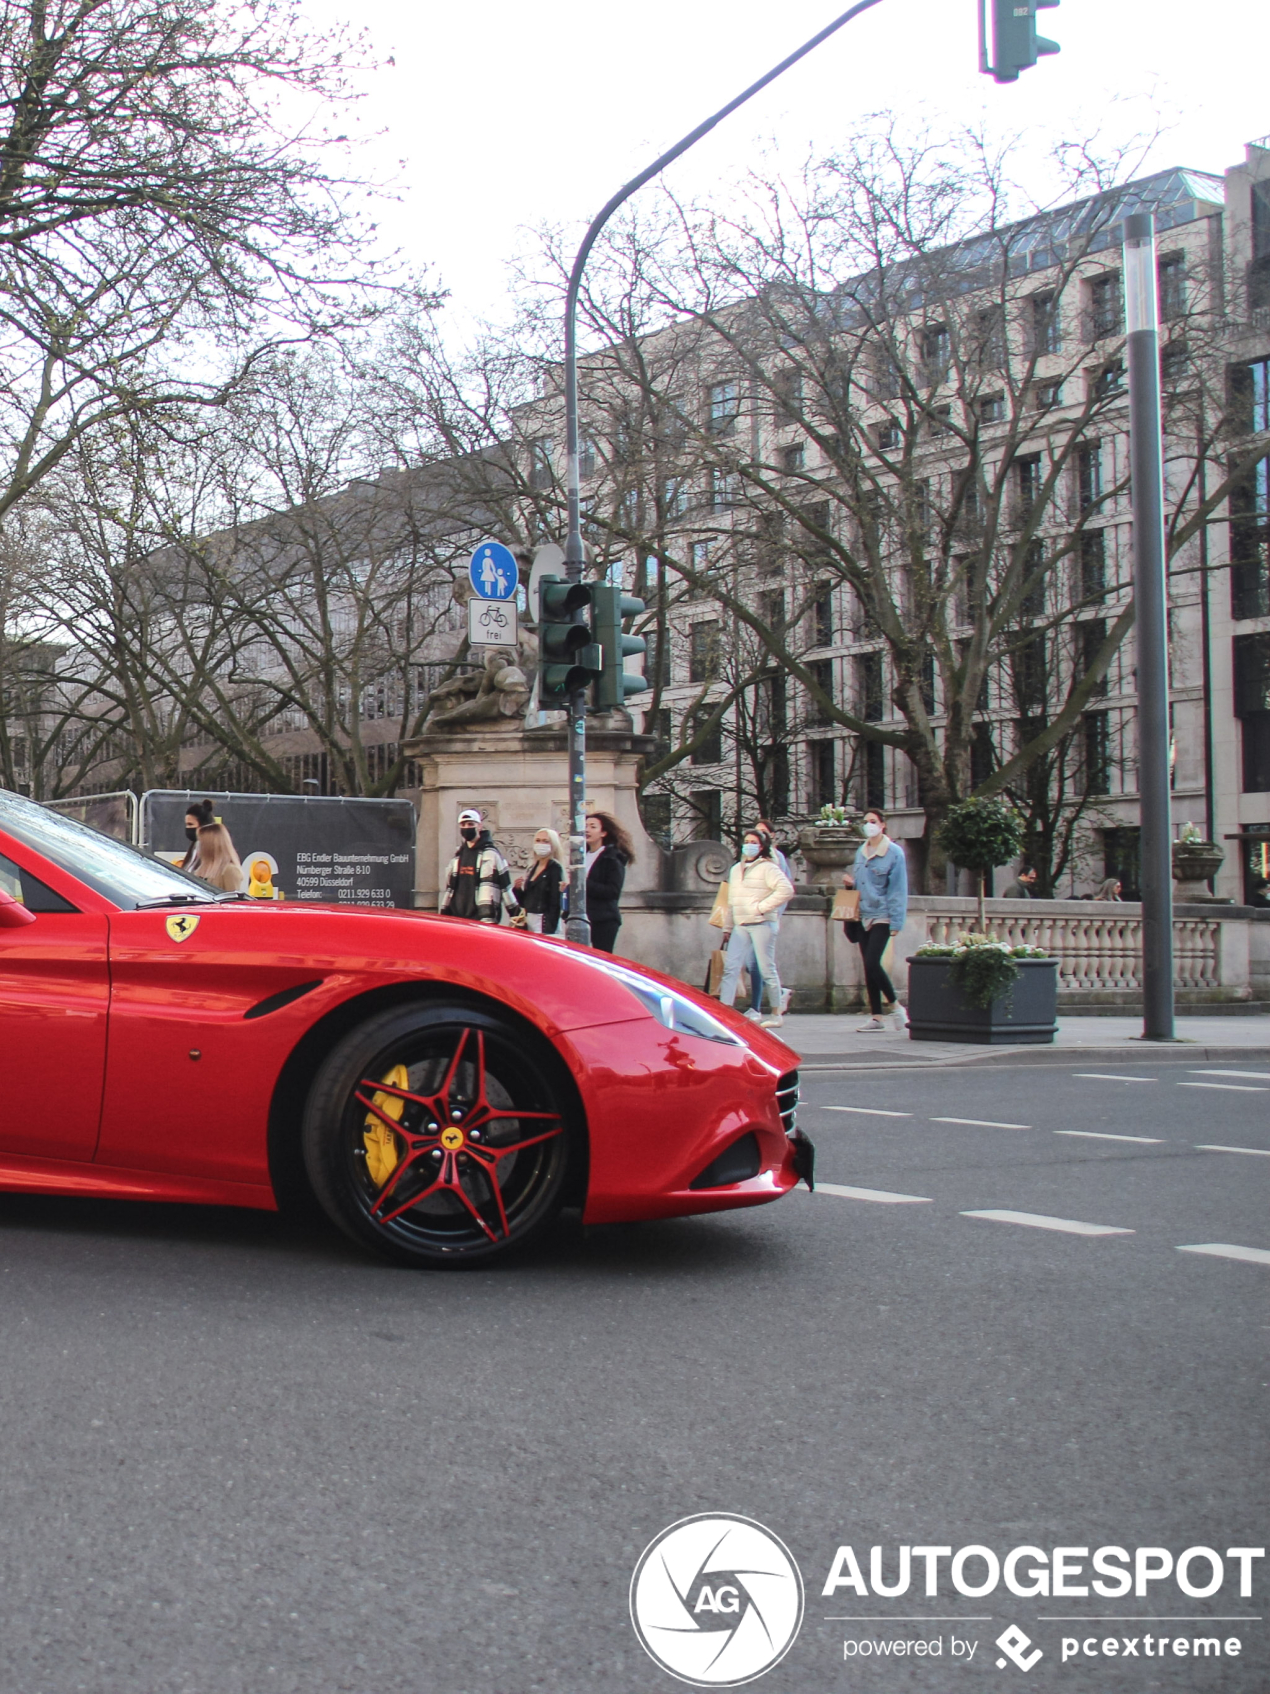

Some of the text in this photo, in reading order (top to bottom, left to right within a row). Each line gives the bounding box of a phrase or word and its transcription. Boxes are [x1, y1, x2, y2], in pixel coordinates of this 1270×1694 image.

[486, 630, 502, 640] frei
[296, 853, 409, 864] EBG Endler Bauunternehmung GmbH
[296, 865, 371, 876] Nürnberger Straße 8-10
[296, 877, 354, 887] 40599 Düsseldorf
[296, 889, 391, 899] Telefon: 0211.929 633 0
